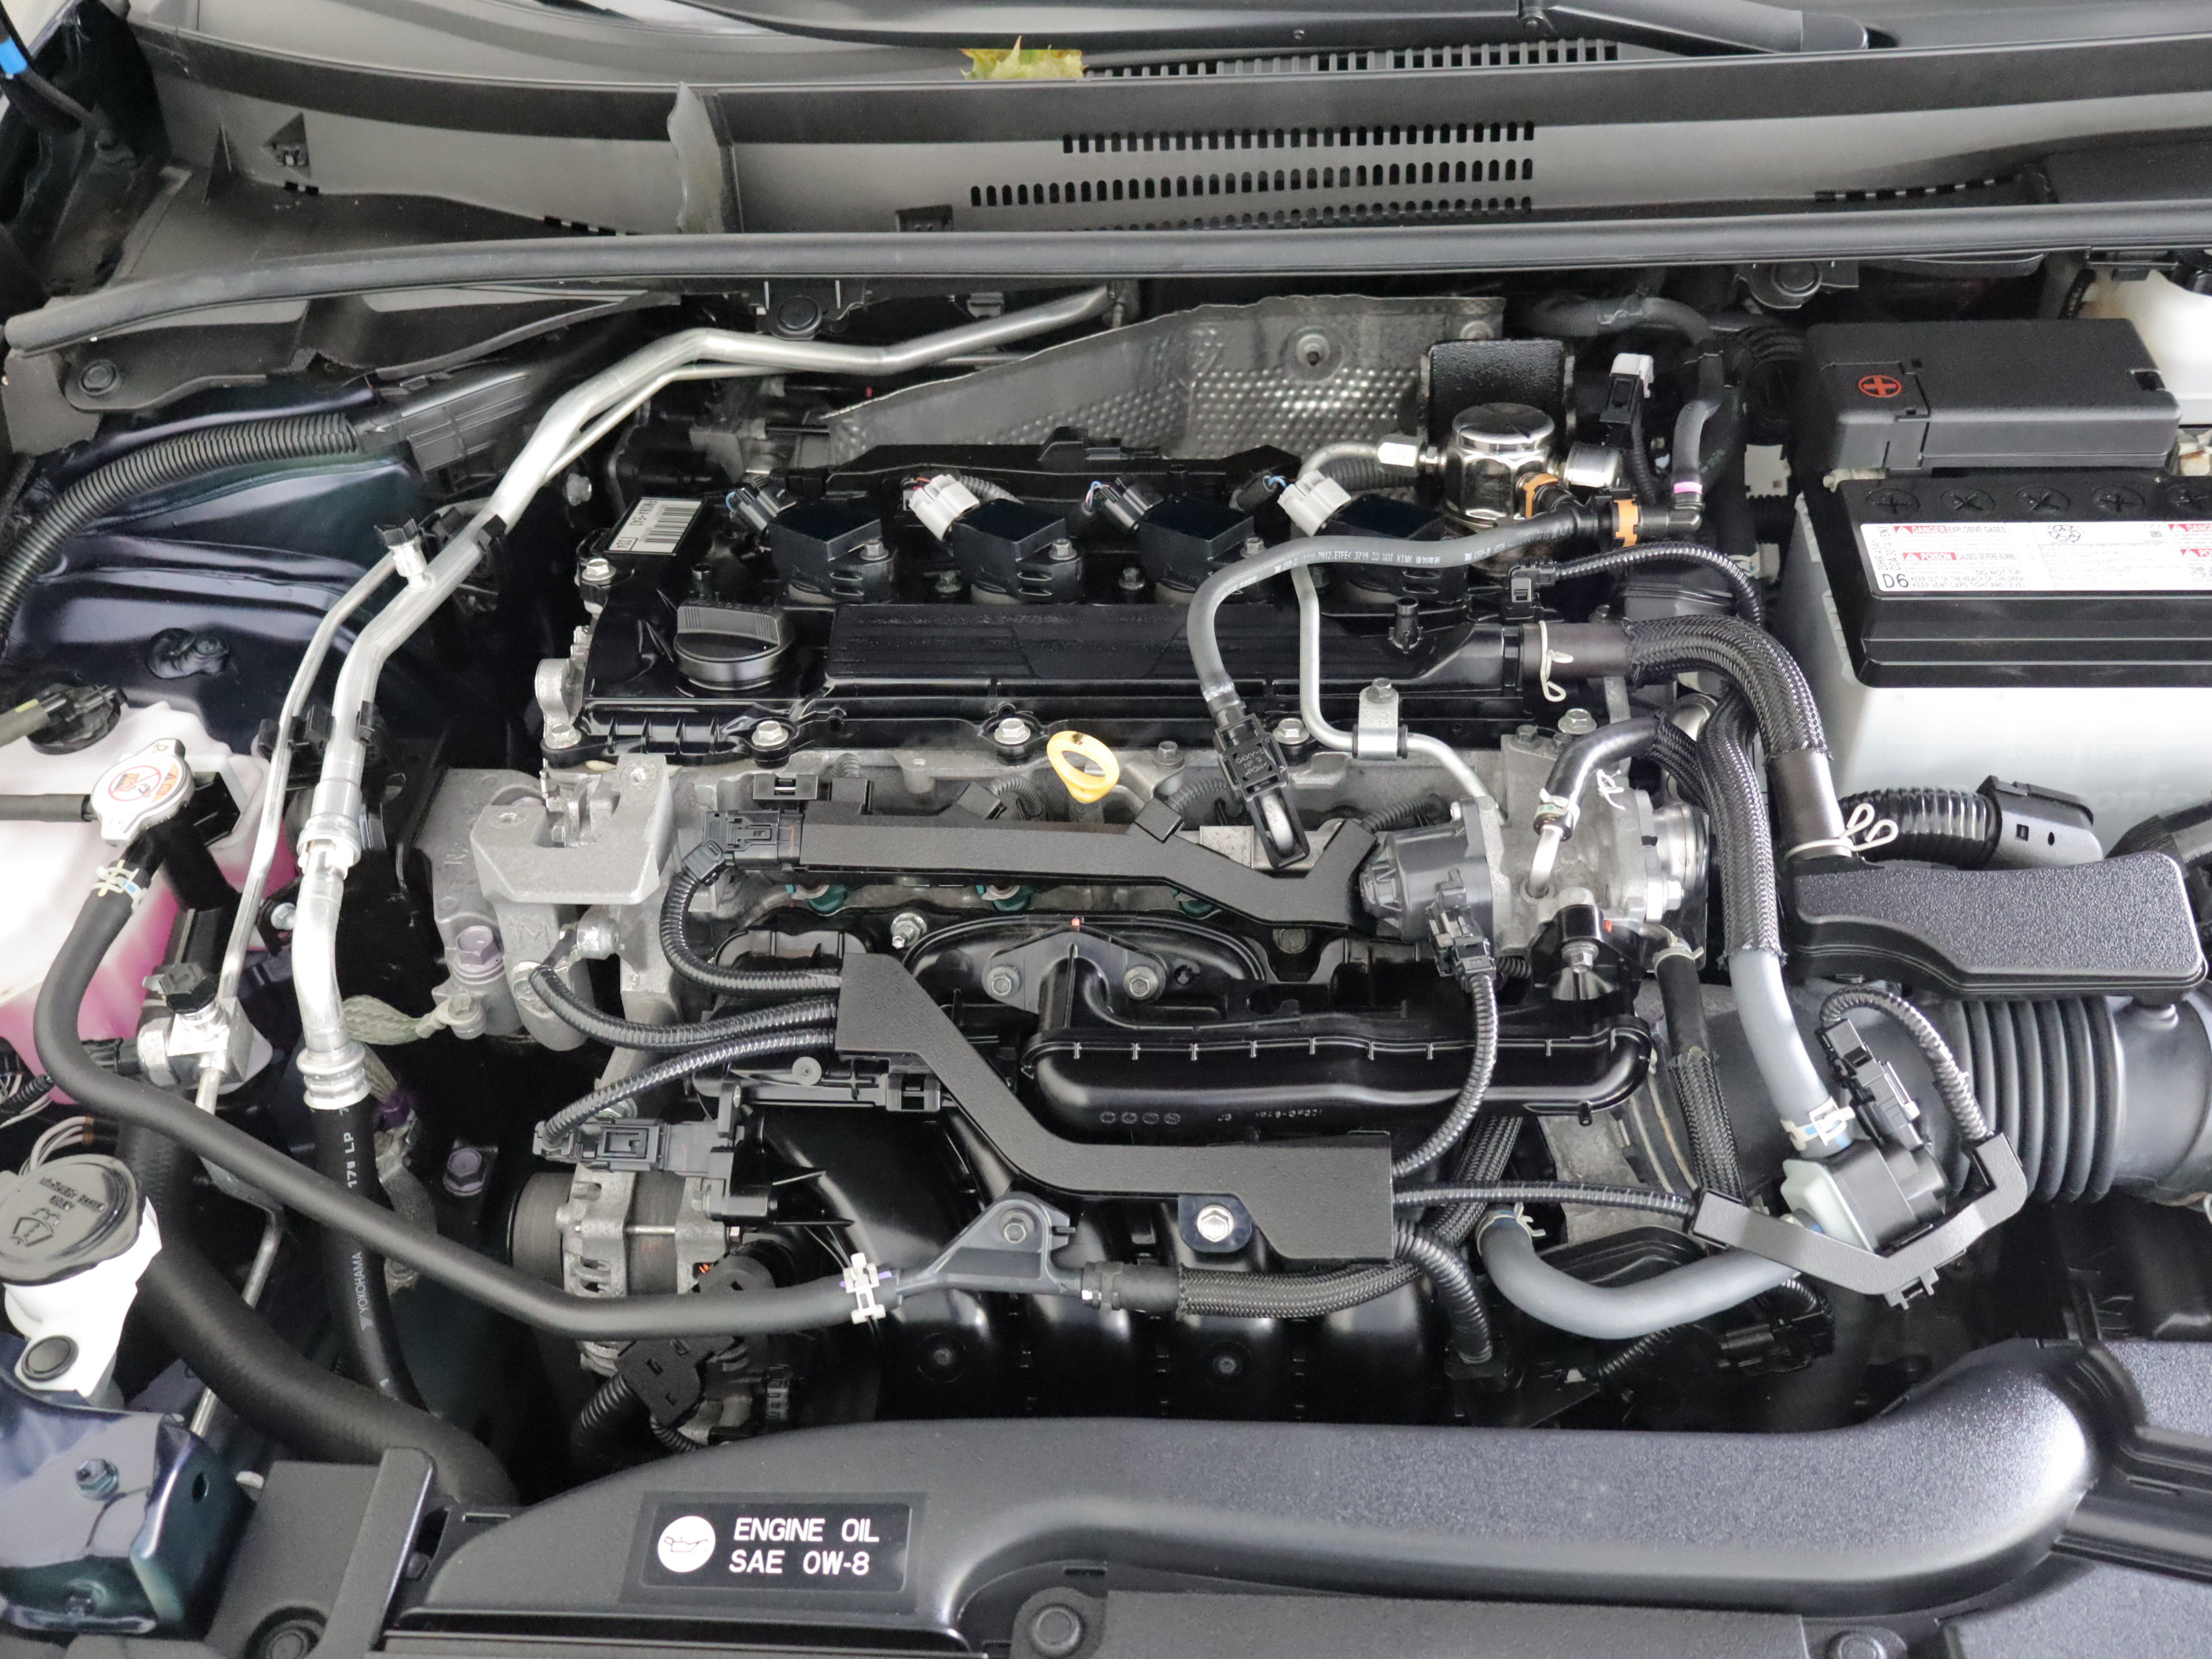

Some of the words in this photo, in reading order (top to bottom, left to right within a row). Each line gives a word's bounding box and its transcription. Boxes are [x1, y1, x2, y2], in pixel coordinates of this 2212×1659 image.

[1382, 553, 1393, 562] NOT
[1397, 554, 1412, 564] KINK
[1888, 557, 1901, 571] CCA
[1883, 573, 1909, 588] D6
[2010, 746, 2080, 759] LOWER
[2091, 746, 2152, 759] LEVEL
[343, 1133, 354, 1154] LP
[352, 1251, 369, 1314] YOKOHAMA
[734, 1518, 825, 1543] ENGINE
[841, 1518, 880, 1543] OIL
[729, 1550, 785, 1574] SAE
[803, 1551, 869, 1576] 0W-8
